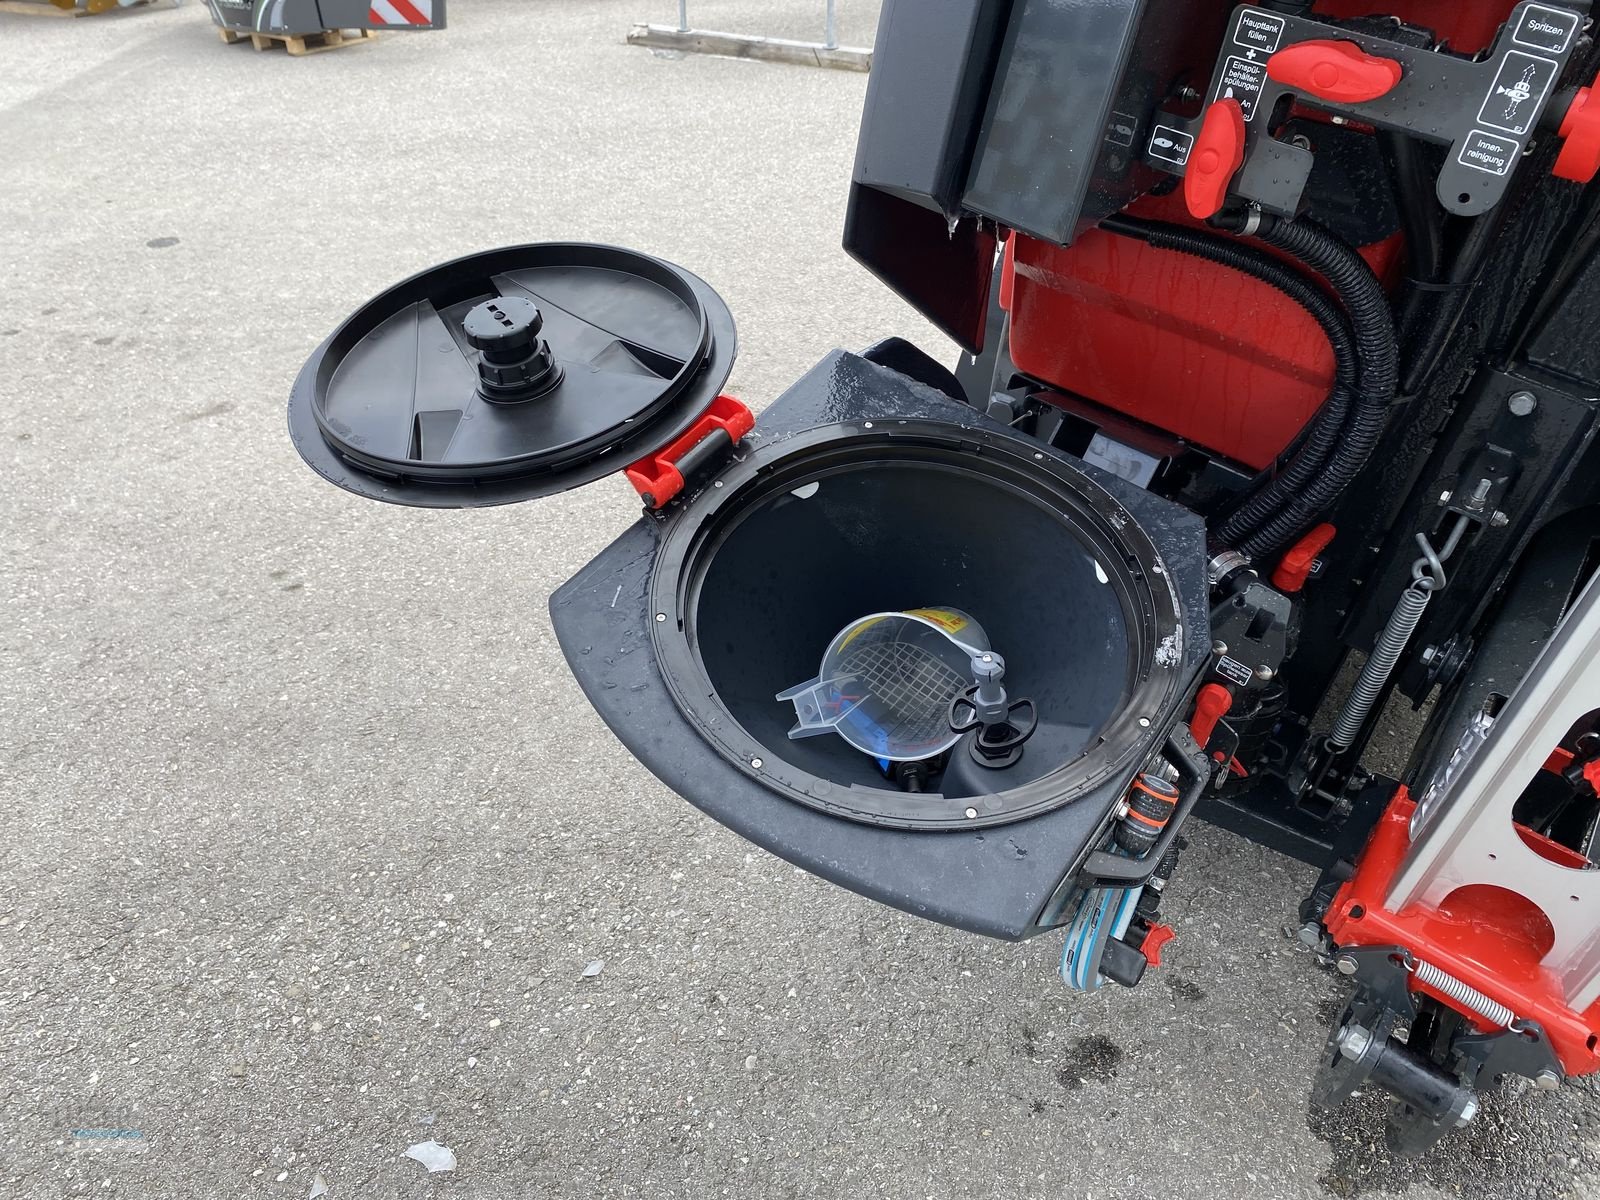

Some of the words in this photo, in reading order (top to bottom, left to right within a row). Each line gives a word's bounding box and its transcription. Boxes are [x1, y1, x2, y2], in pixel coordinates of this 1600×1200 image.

[1242, 17, 1278, 33] Haupttank
[1528, 19, 1563, 36] Spritzen
[1247, 30, 1267, 42] füllen
[1232, 61, 1260, 75] Einspül-
[1228, 70, 1259, 83] behälter-
[1224, 77, 1259, 92] spülungen
[1241, 99, 1251, 108] An
[1173, 143, 1186, 153] Aus
[1477, 139, 1504, 154] Innen-
[1467, 150, 1504, 167] reinigung
